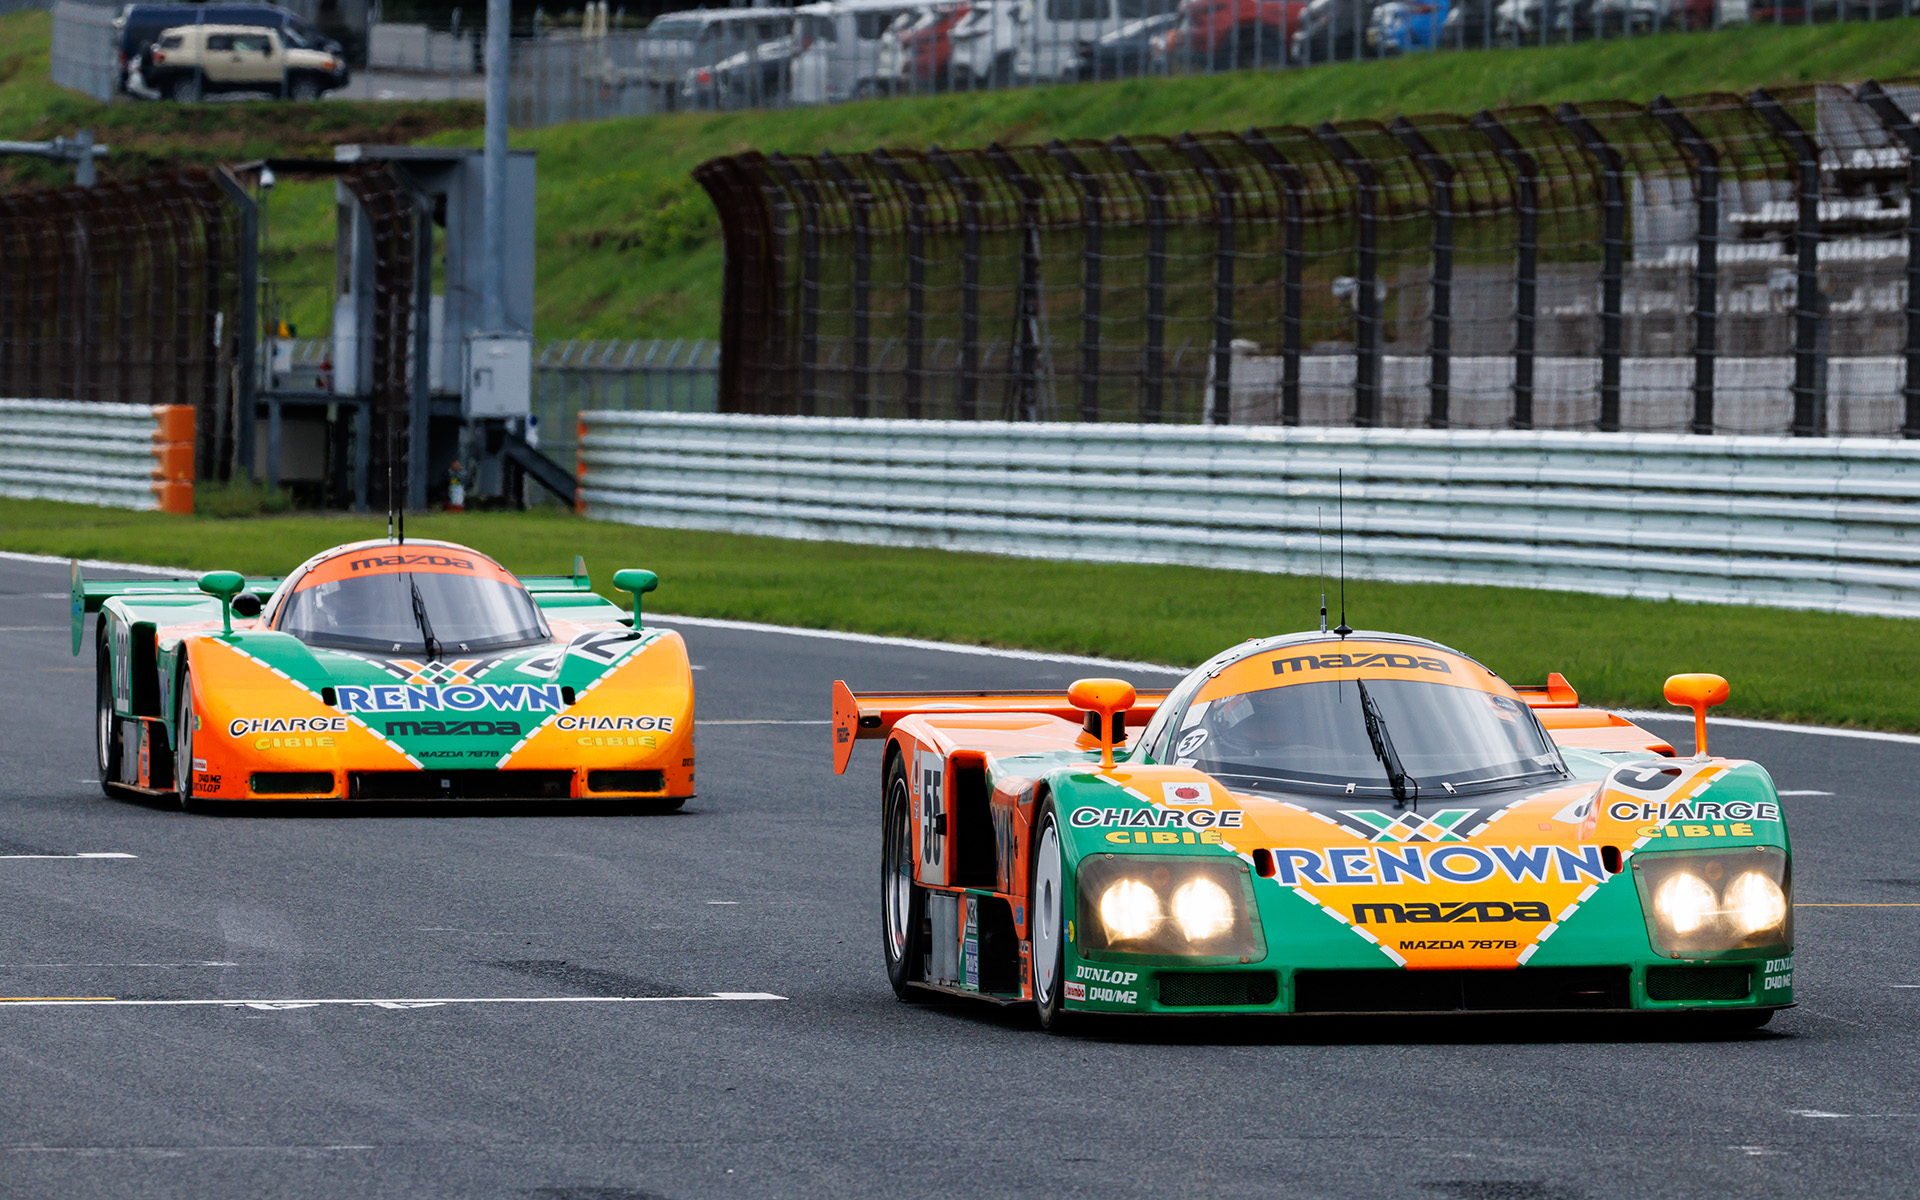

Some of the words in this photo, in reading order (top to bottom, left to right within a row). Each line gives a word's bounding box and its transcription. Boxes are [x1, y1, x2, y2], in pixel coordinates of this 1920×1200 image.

[1272, 653, 1452, 676] mazda
[335, 684, 565, 714] RENOWN
[228, 716, 348, 738] CHARGE
[385, 721, 521, 736] mazda
[555, 715, 674, 734] CHARGE
[1180, 733, 1206, 752] 37
[418, 750, 464, 758] MAZDA
[466, 750, 500, 758] 787B
[924, 769, 942, 867] 55
[1069, 806, 1245, 829] CHARGE
[1608, 801, 1779, 823] CHARGE
[1270, 845, 1609, 887] RENOWN
[1352, 901, 1551, 924] mazda
[1400, 940, 1465, 950] MAZDA
[1468, 940, 1517, 949] 787B
[1076, 965, 1138, 986] DUNLOP
[1067, 984, 1085, 999] brembo
[1089, 986, 1138, 1004] D40/M2
